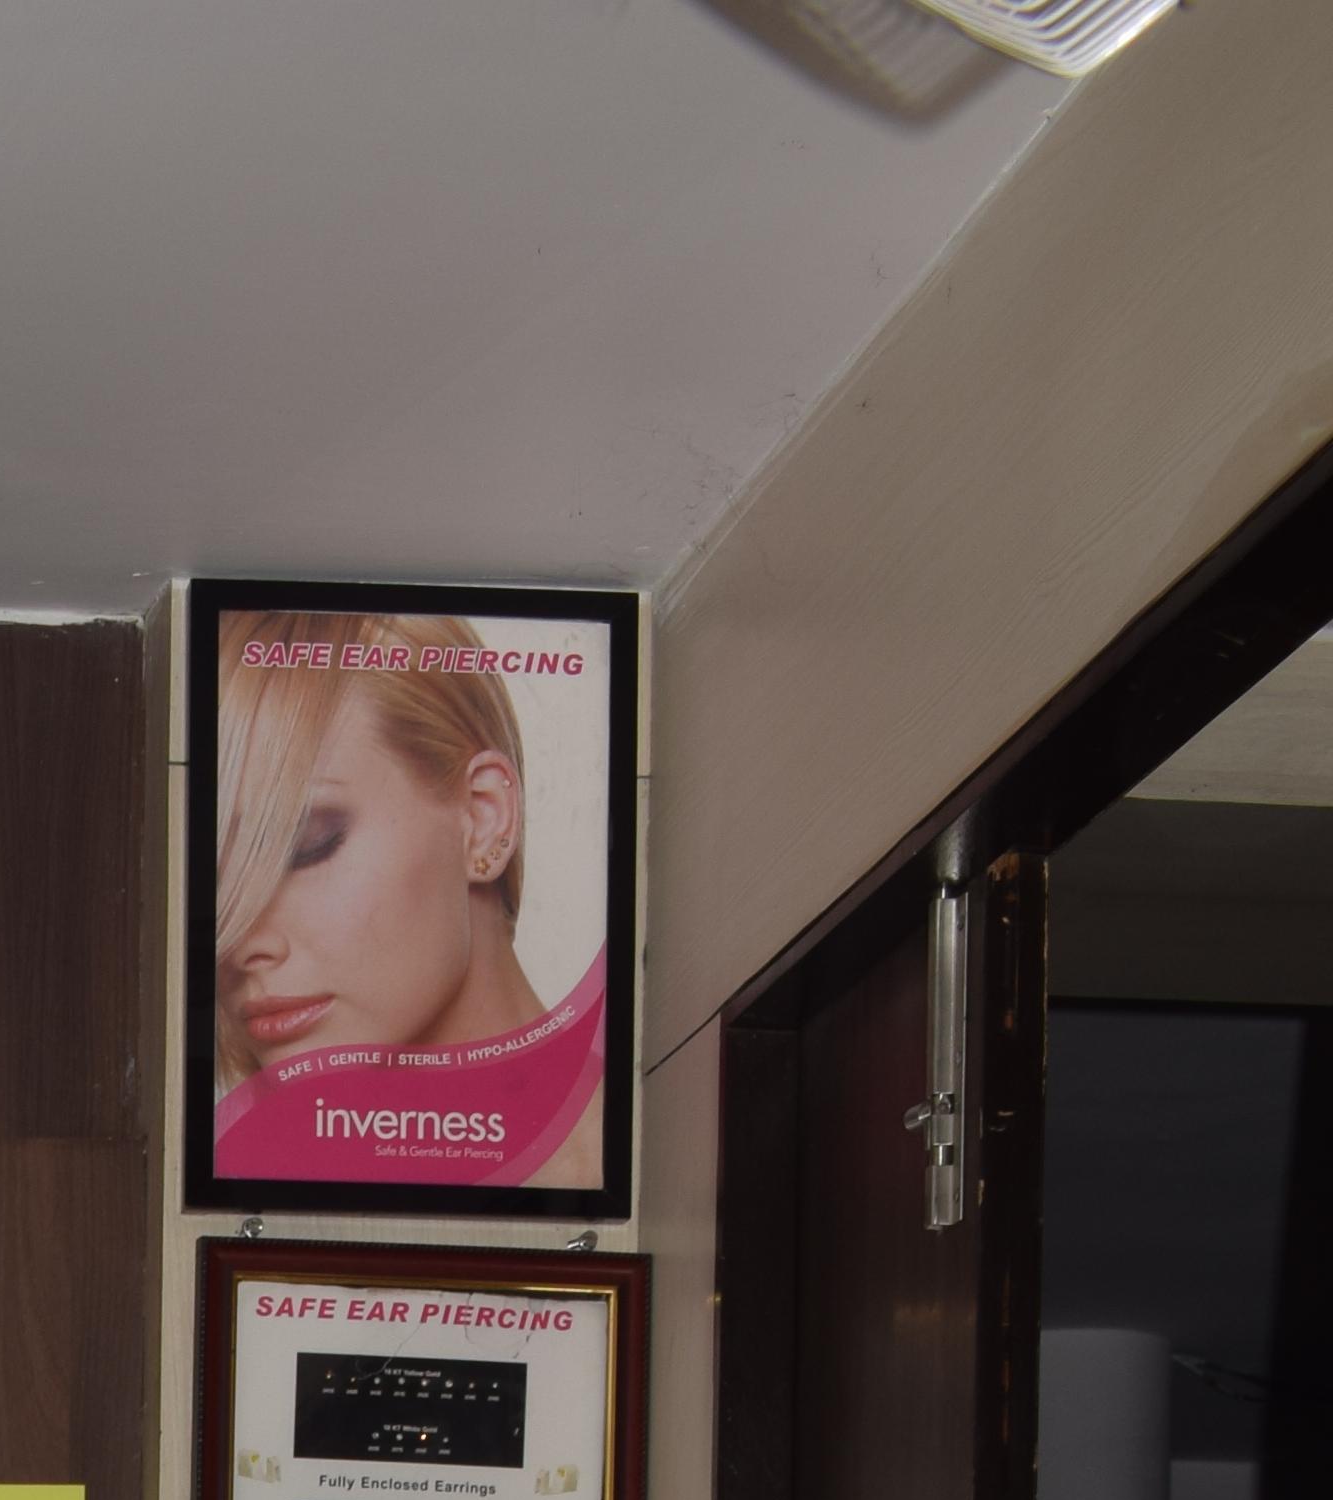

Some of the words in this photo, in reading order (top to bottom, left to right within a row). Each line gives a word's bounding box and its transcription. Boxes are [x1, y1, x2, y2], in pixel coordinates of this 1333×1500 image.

[242, 641, 331, 668] SAFE
[340, 644, 411, 671] EAR
[418, 646, 585, 676] PIERCING
[277, 1059, 312, 1082] SAFE
[328, 1051, 382, 1066] GENTLE
[397, 1052, 452, 1066] STERILE
[466, 1004, 577, 1062] HYPO-ALLERGENIC
[314, 1097, 506, 1143] inverness
[374, 1145, 397, 1157] Safe
[399, 1146, 407, 1157] &
[409, 1145, 443, 1158] Gentle
[445, 1146, 462, 1158] Ear
[464, 1146, 504, 1161] Piercing
[255, 1296, 337, 1319] SAFE
[346, 1300, 411, 1323] EAR
[420, 1303, 574, 1332] PIERCING
[318, 1475, 356, 1491] Fully
[361, 1476, 429, 1491] Enclosed
[434, 1480, 497, 1497] Earrings
